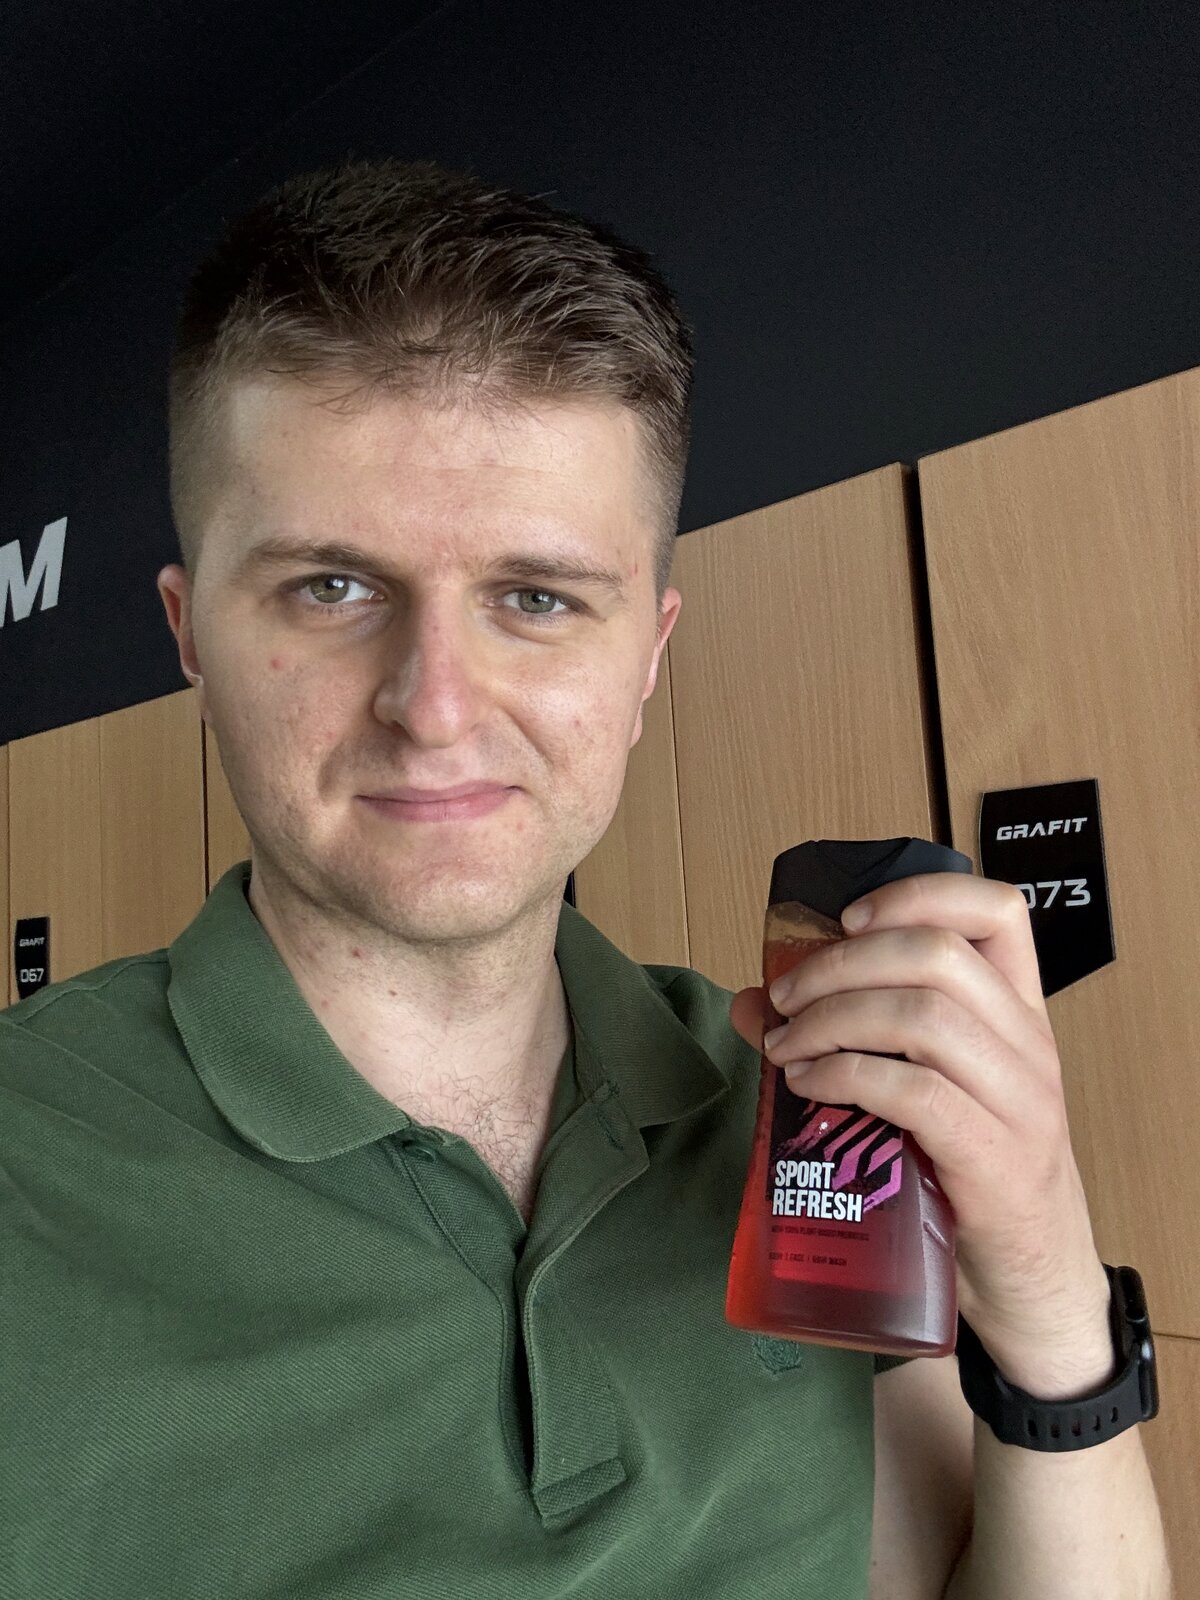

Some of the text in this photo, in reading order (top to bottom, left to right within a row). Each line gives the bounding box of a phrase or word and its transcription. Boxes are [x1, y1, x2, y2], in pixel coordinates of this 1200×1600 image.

[0, 516, 68, 628] M
[996, 817, 1088, 841] GRAFIT
[21, 968, 44, 983] 067
[775, 1160, 835, 1189] SPORT
[772, 1189, 863, 1222] REFRESH
